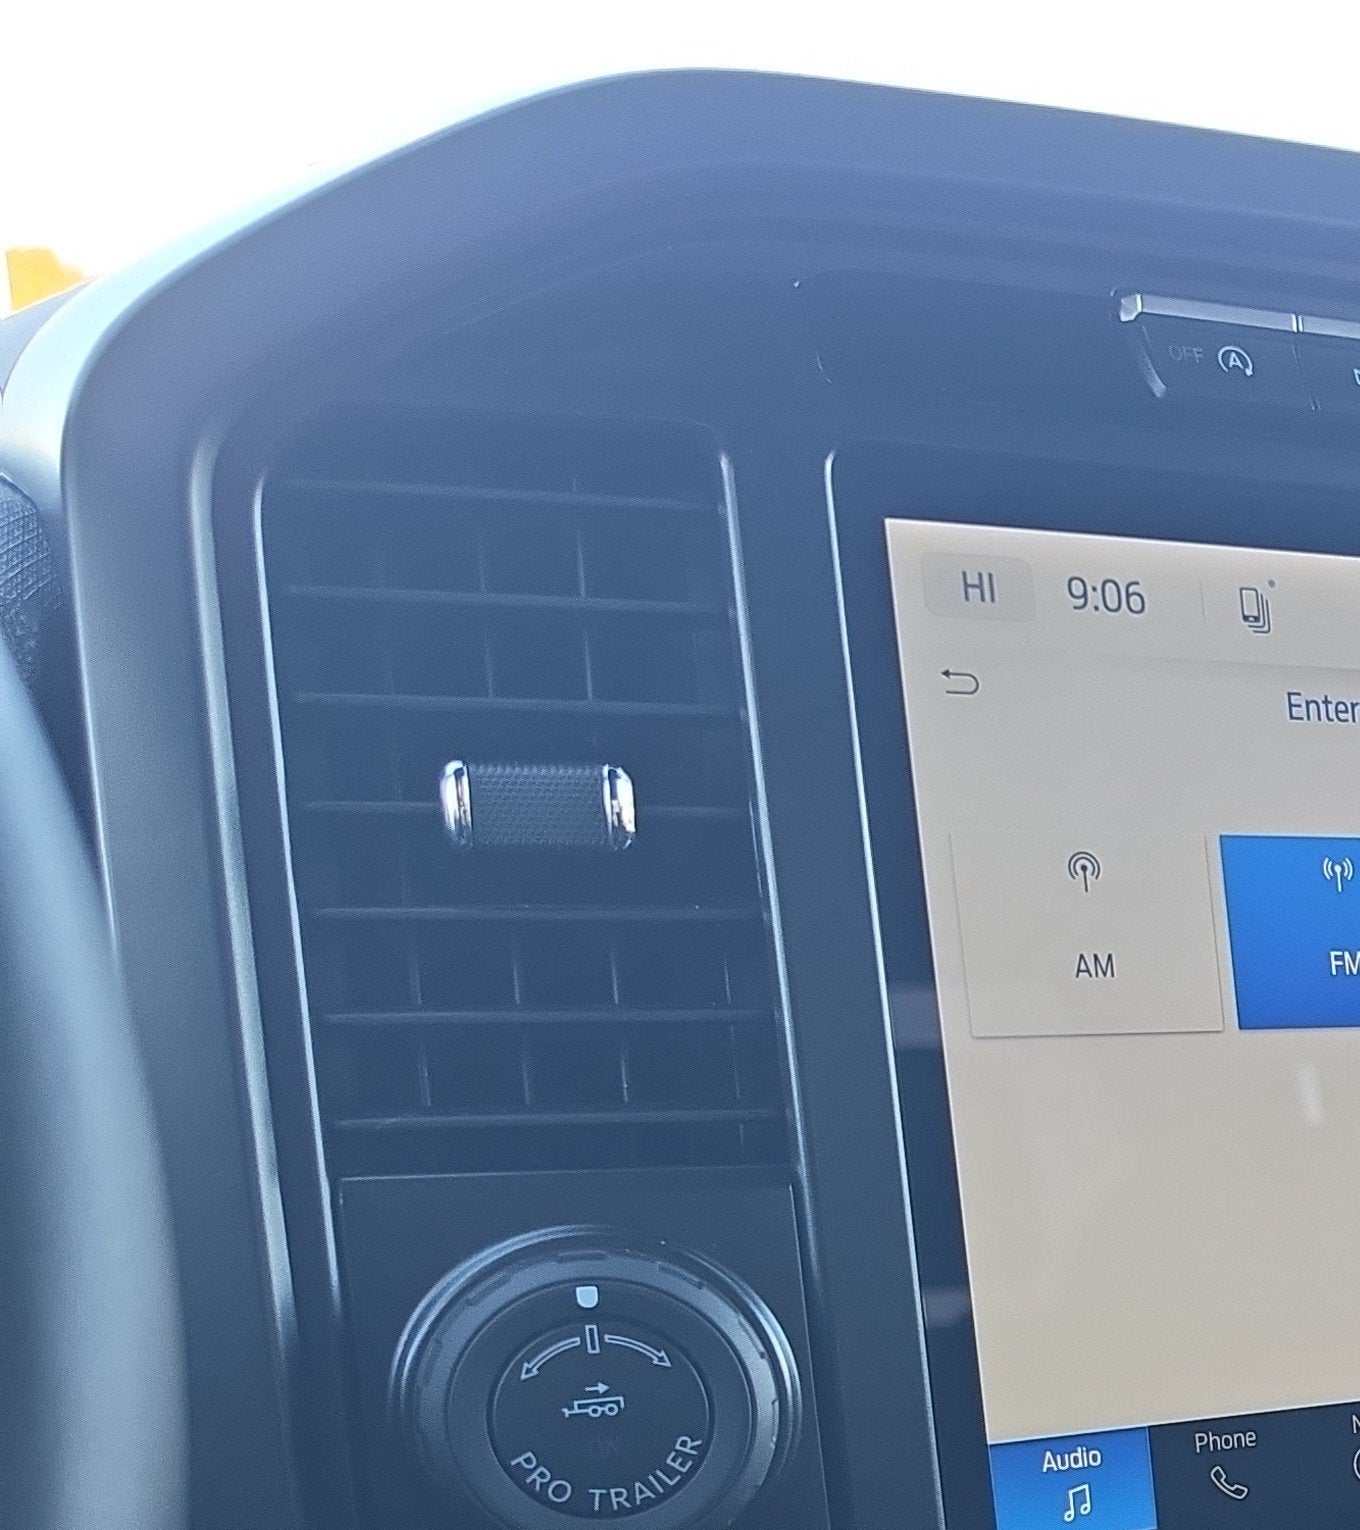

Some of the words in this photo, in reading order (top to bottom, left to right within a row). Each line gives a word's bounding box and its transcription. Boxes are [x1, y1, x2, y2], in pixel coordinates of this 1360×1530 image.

[962, 570, 998, 605] HI
[1066, 575, 1148, 616] 9:06
[1074, 952, 1117, 980] AM
[1193, 1428, 1258, 1454] Phone
[510, 1451, 572, 1503] PRO
[588, 1434, 703, 1512] TRAILER
[1042, 1446, 1103, 1474] Audio
